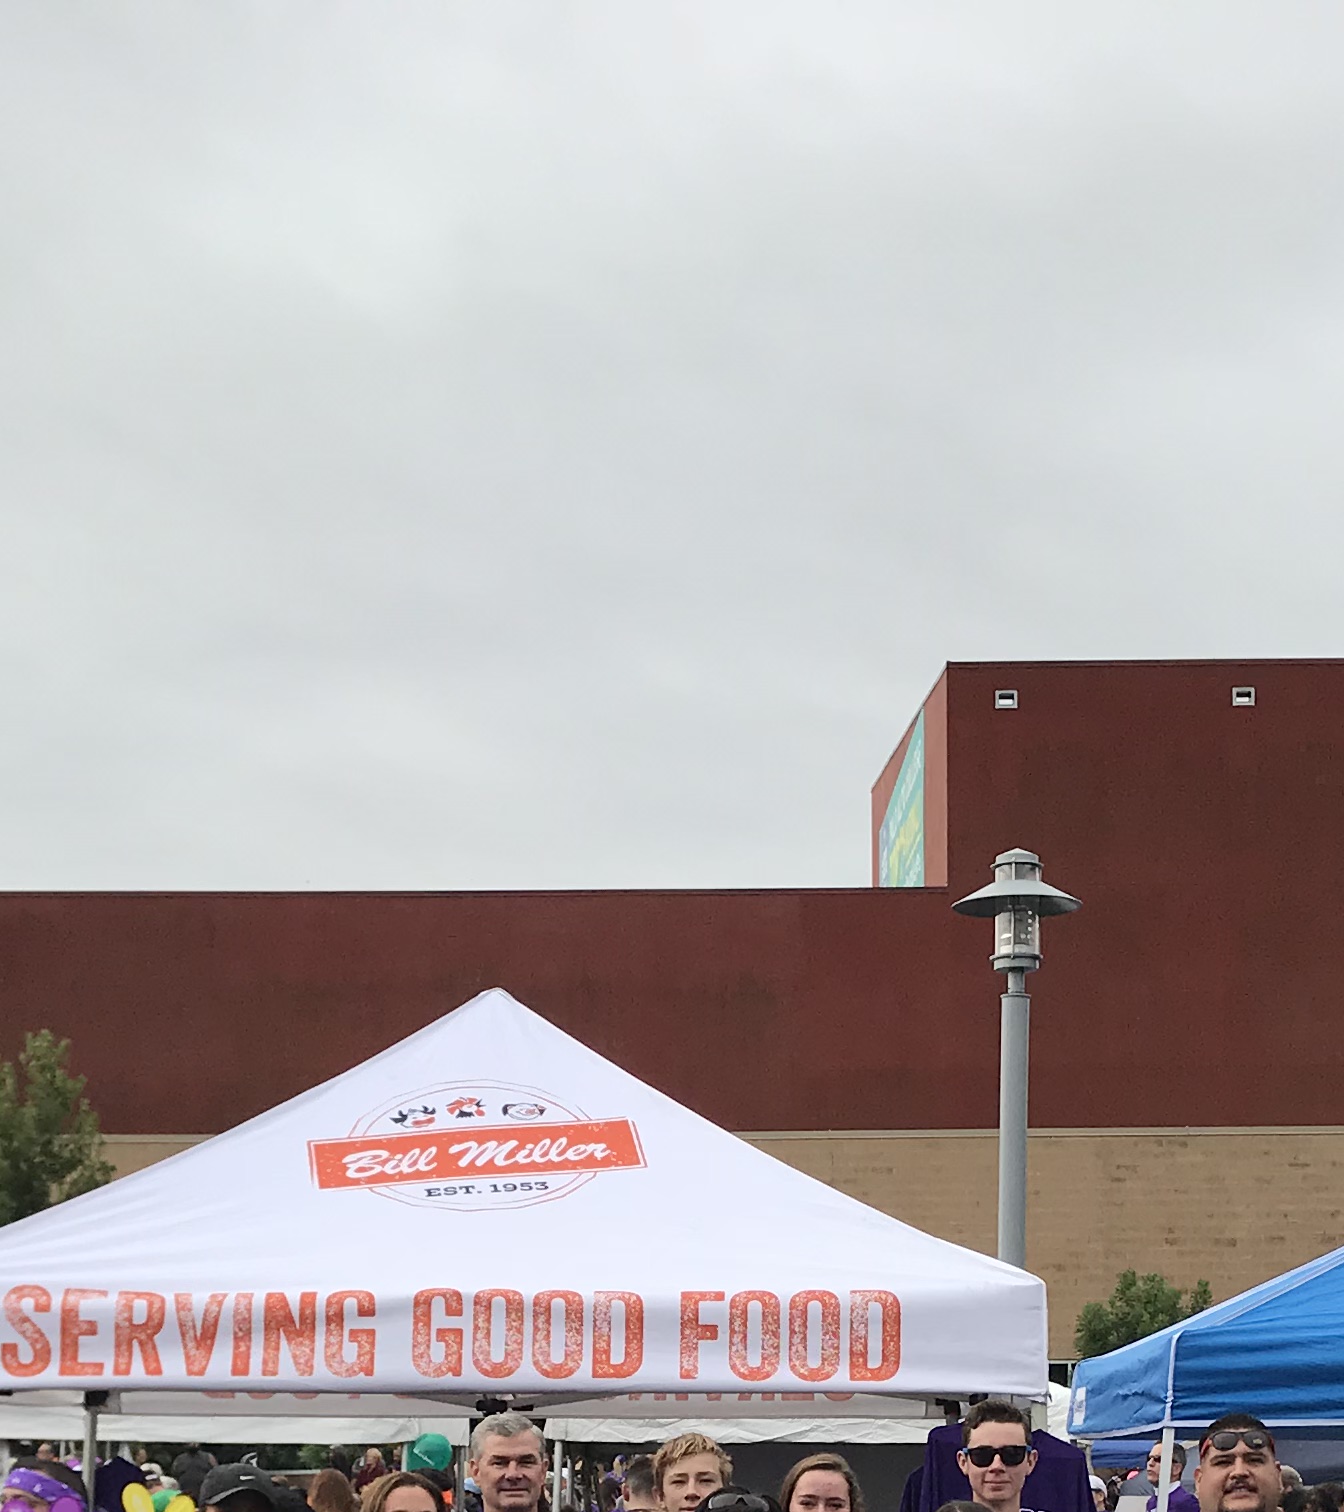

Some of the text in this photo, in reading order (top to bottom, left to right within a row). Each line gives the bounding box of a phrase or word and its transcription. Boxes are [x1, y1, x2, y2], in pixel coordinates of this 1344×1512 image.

[342, 1137, 613, 1179] Bill Miller
[424, 1181, 549, 1198] EST. 1953
[0, 1284, 902, 1382] SERVING GOOD FOOD
